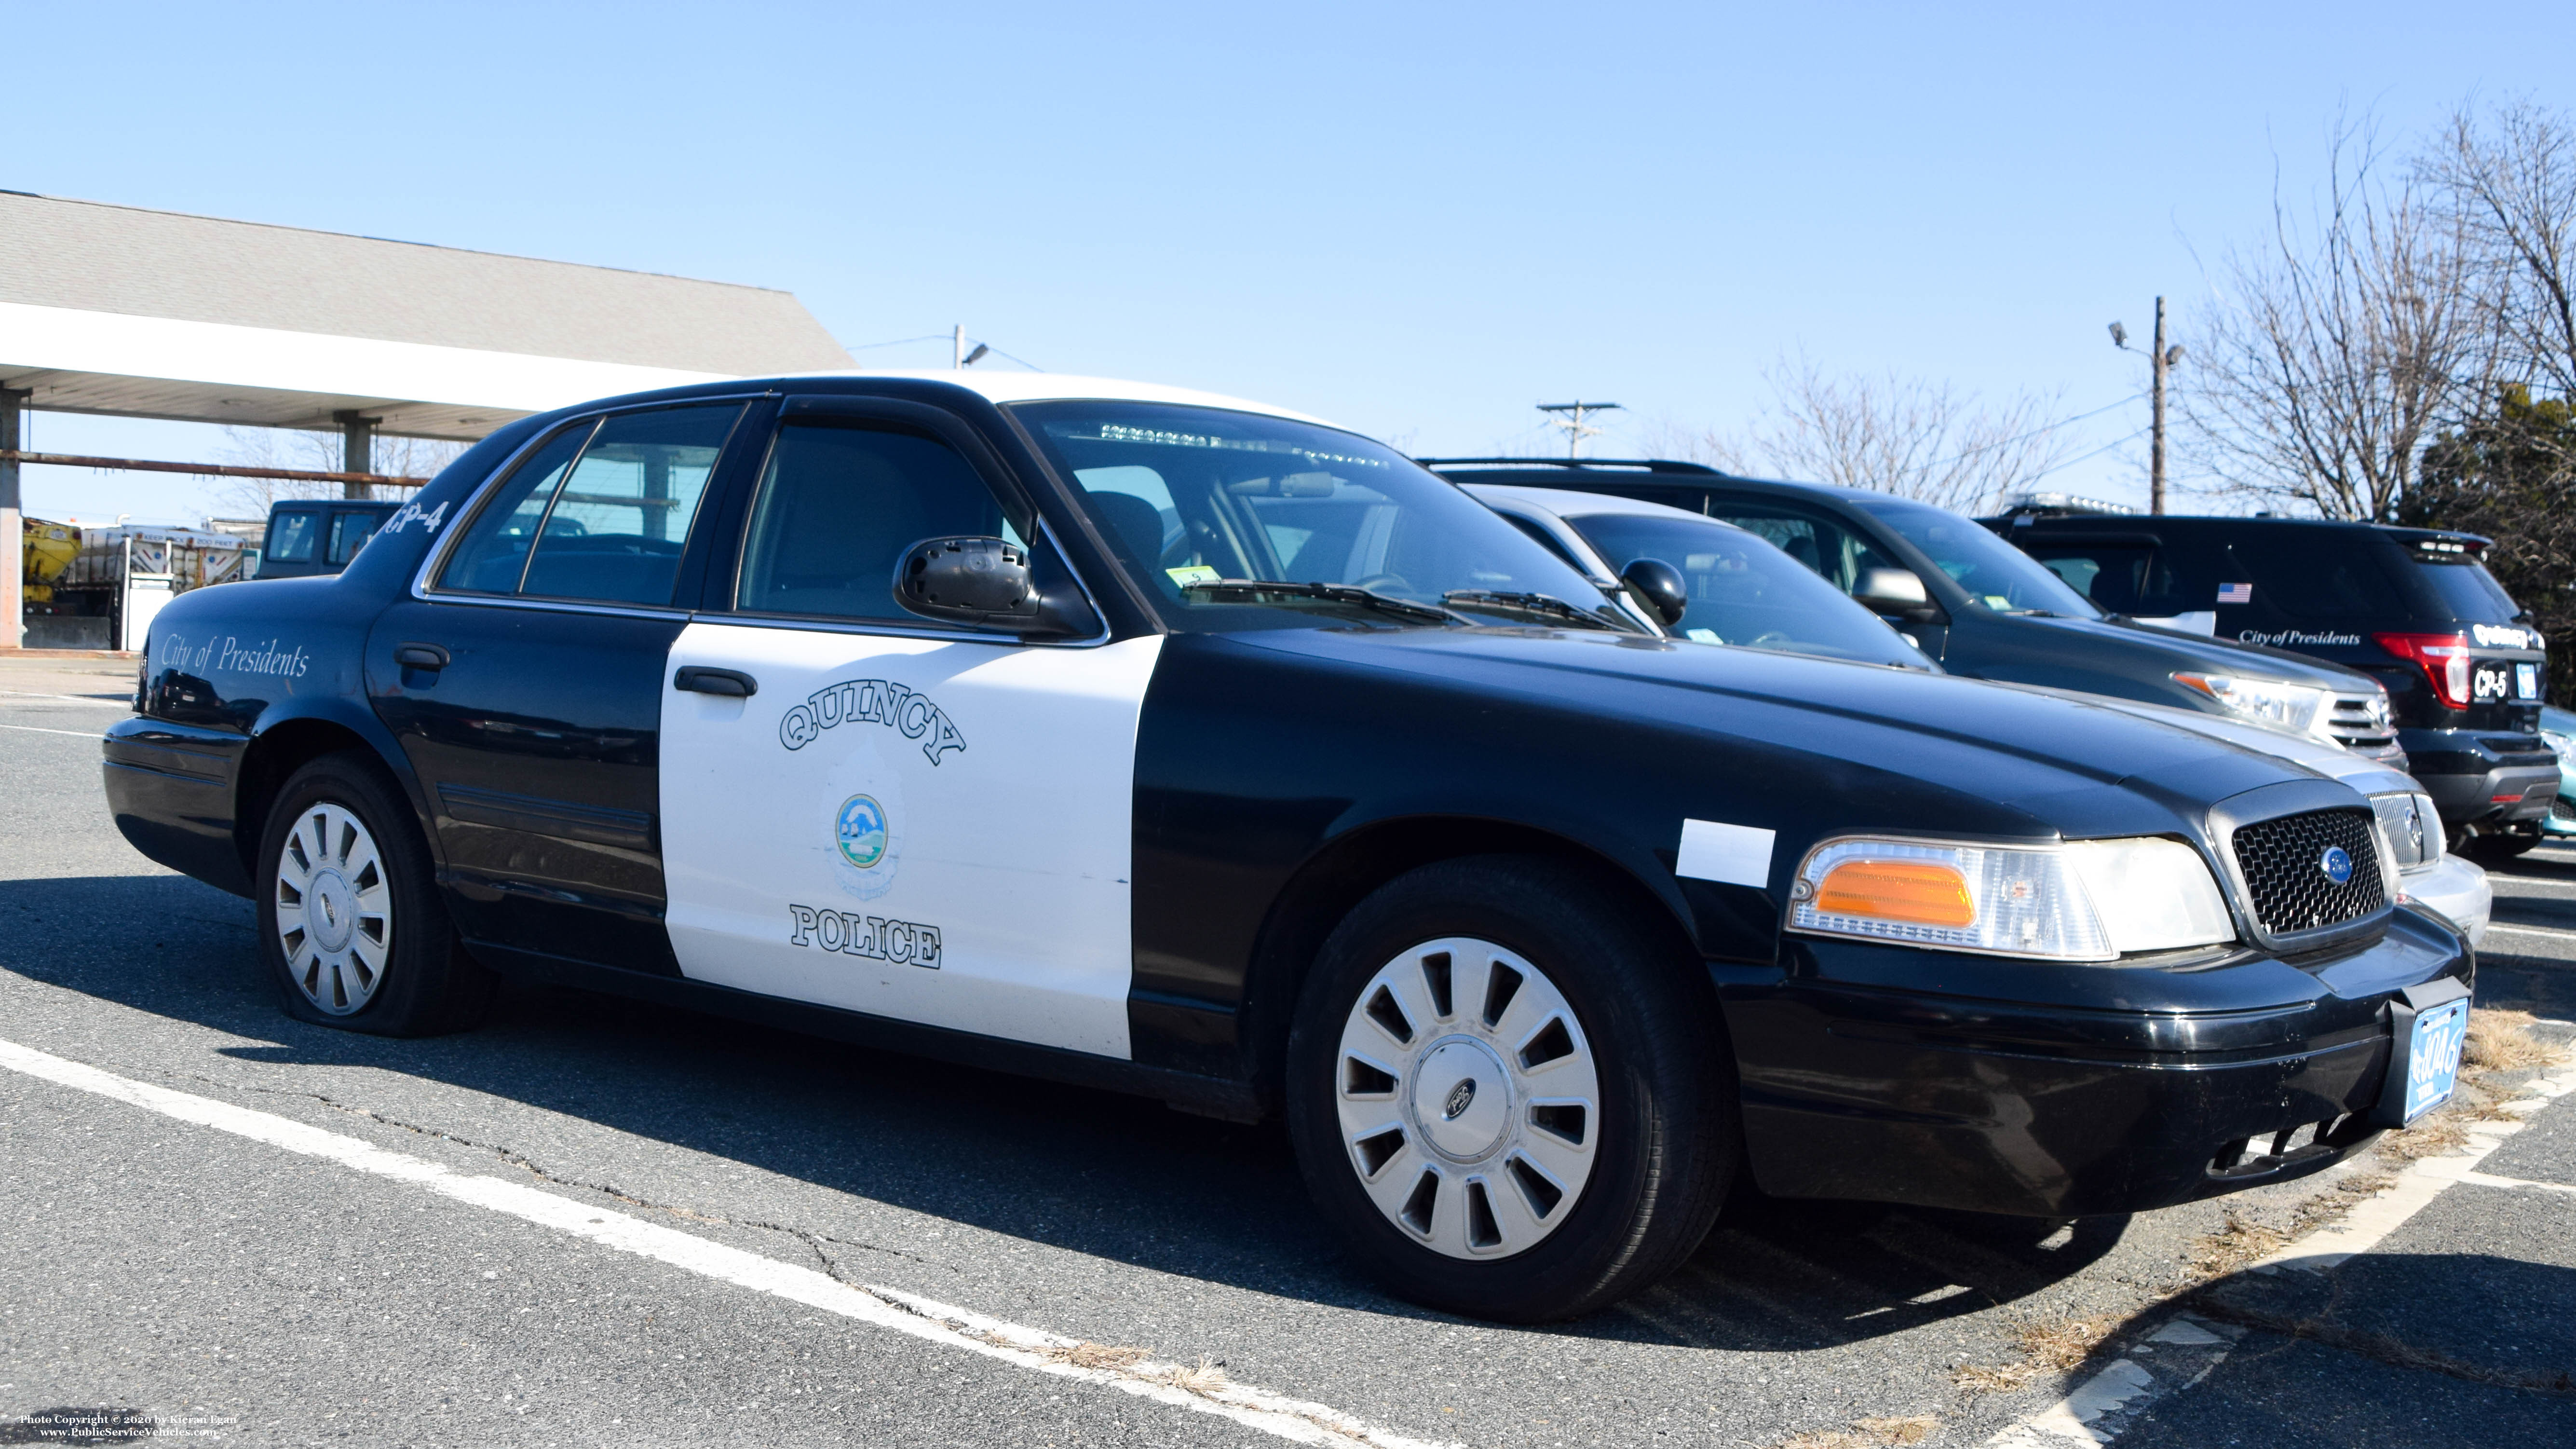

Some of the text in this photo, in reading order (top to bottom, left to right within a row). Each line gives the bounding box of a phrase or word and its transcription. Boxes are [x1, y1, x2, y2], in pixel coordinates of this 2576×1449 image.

[2239, 629, 2361, 648] City of Presidents
[2472, 624, 2528, 650] Quincy
[162, 633, 309, 677] City of Presidents
[2474, 669, 2507, 697] CP-5
[779, 679, 966, 766] QUINCY
[789, 903, 941, 970] POLICE
[1451, 1086, 1470, 1111] Ford
